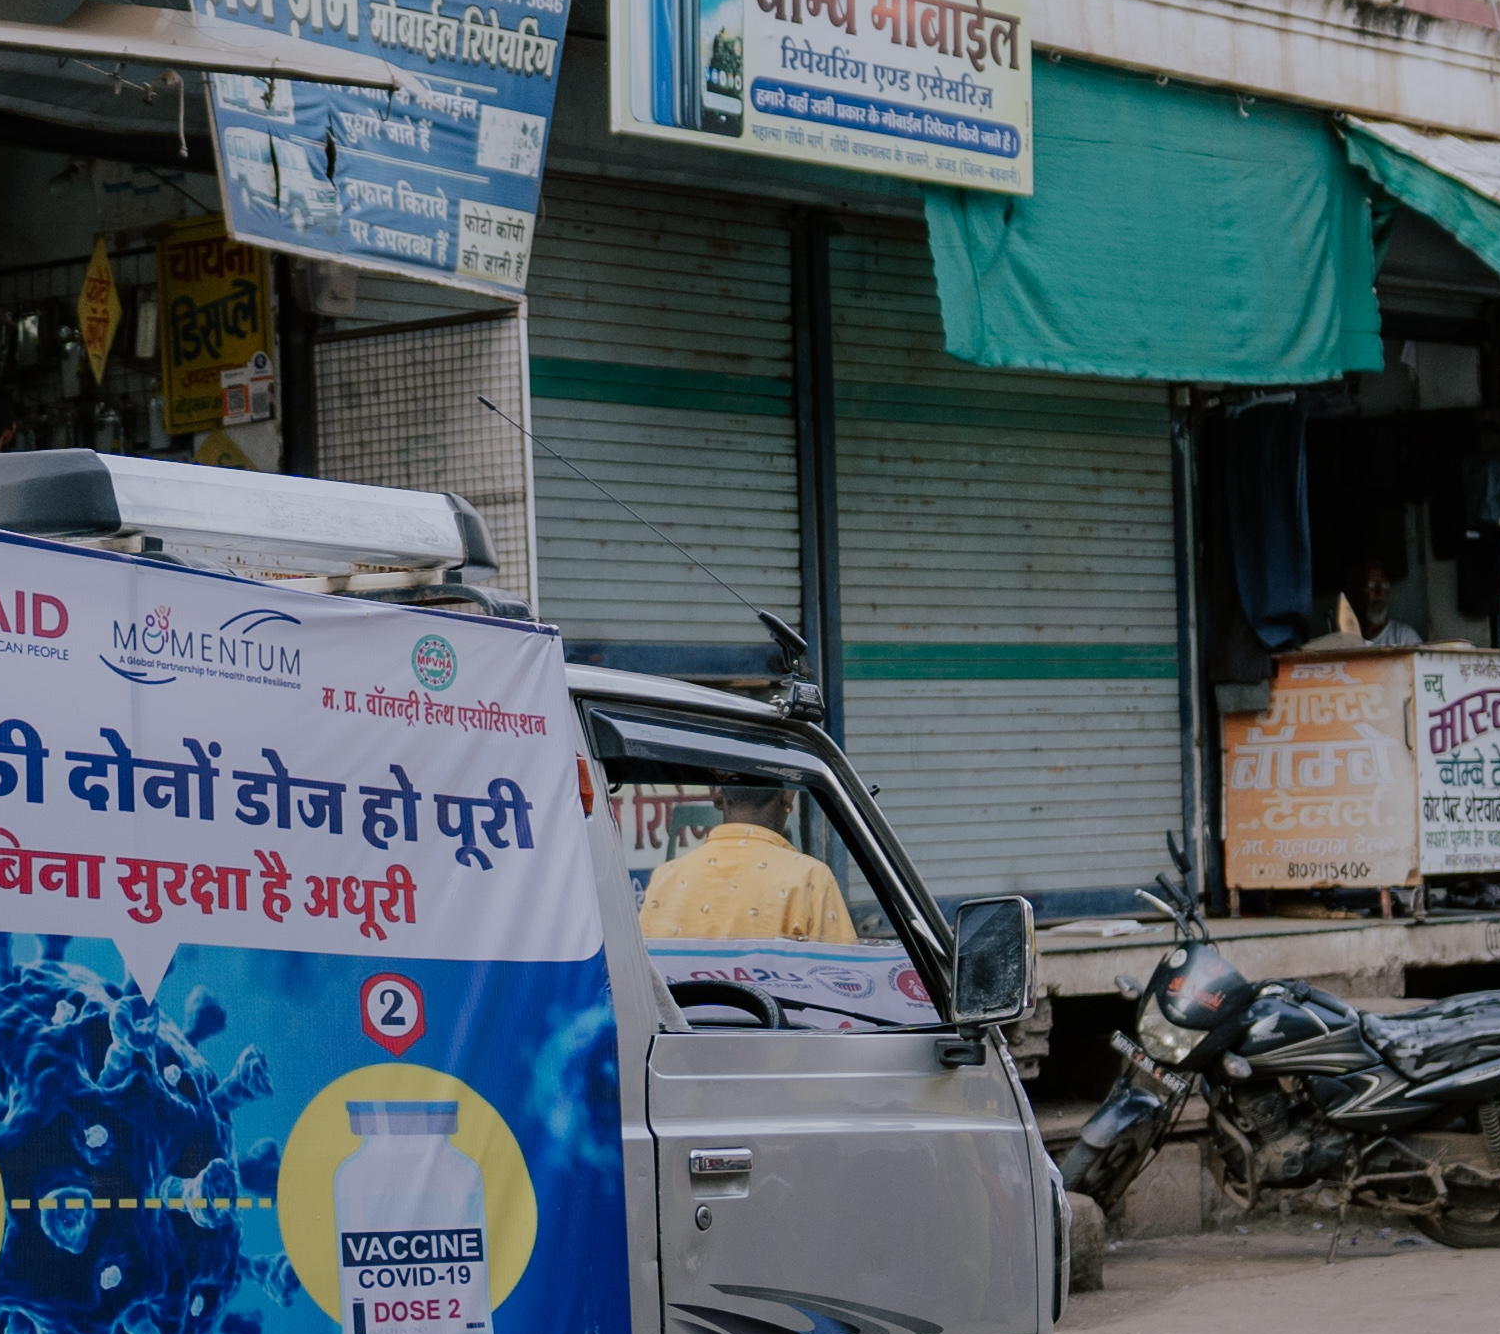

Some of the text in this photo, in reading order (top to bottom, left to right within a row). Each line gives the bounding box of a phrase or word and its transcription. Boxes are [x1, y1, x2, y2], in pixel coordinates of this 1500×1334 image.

[781, 39, 866, 84] रिपेयरिंग
[873, 62, 910, 93] एण्ड
[756, 87, 786, 108] हमारे
[812, 95, 834, 118] सभी
[868, 105, 880, 125] के
[464, 207, 526, 243] फोटो कॉपी
[462, 244, 510, 276] की जाती
[27, 644, 69, 661] PEOPLE
[113, 620, 300, 675] MOMENTUM
[417, 653, 453, 669] MPVHA
[1256, 684, 1390, 725] मास्टर
[1423, 674, 1445, 701] न्यू
[425, 693, 454, 726] हेल्थ
[1231, 723, 1398, 790] बॉम्बे
[1436, 748, 1485, 788] बॉम्बे
[65, 728, 222, 820] दोनों
[232, 748, 346, 834] डोज
[359, 764, 421, 850] हो
[434, 777, 534, 871] पूरी
[1288, 861, 1371, 879] 8109115400
[116, 857, 251, 924] सुरक्षा
[254, 850, 292, 923] है
[304, 864, 417, 941] अधूरी
[377, 988, 405, 1027] 2
[347, 1234, 479, 1261] VACCINE
[359, 1265, 471, 1289] COVID-19
[374, 1299, 461, 1323] DOSE 2
